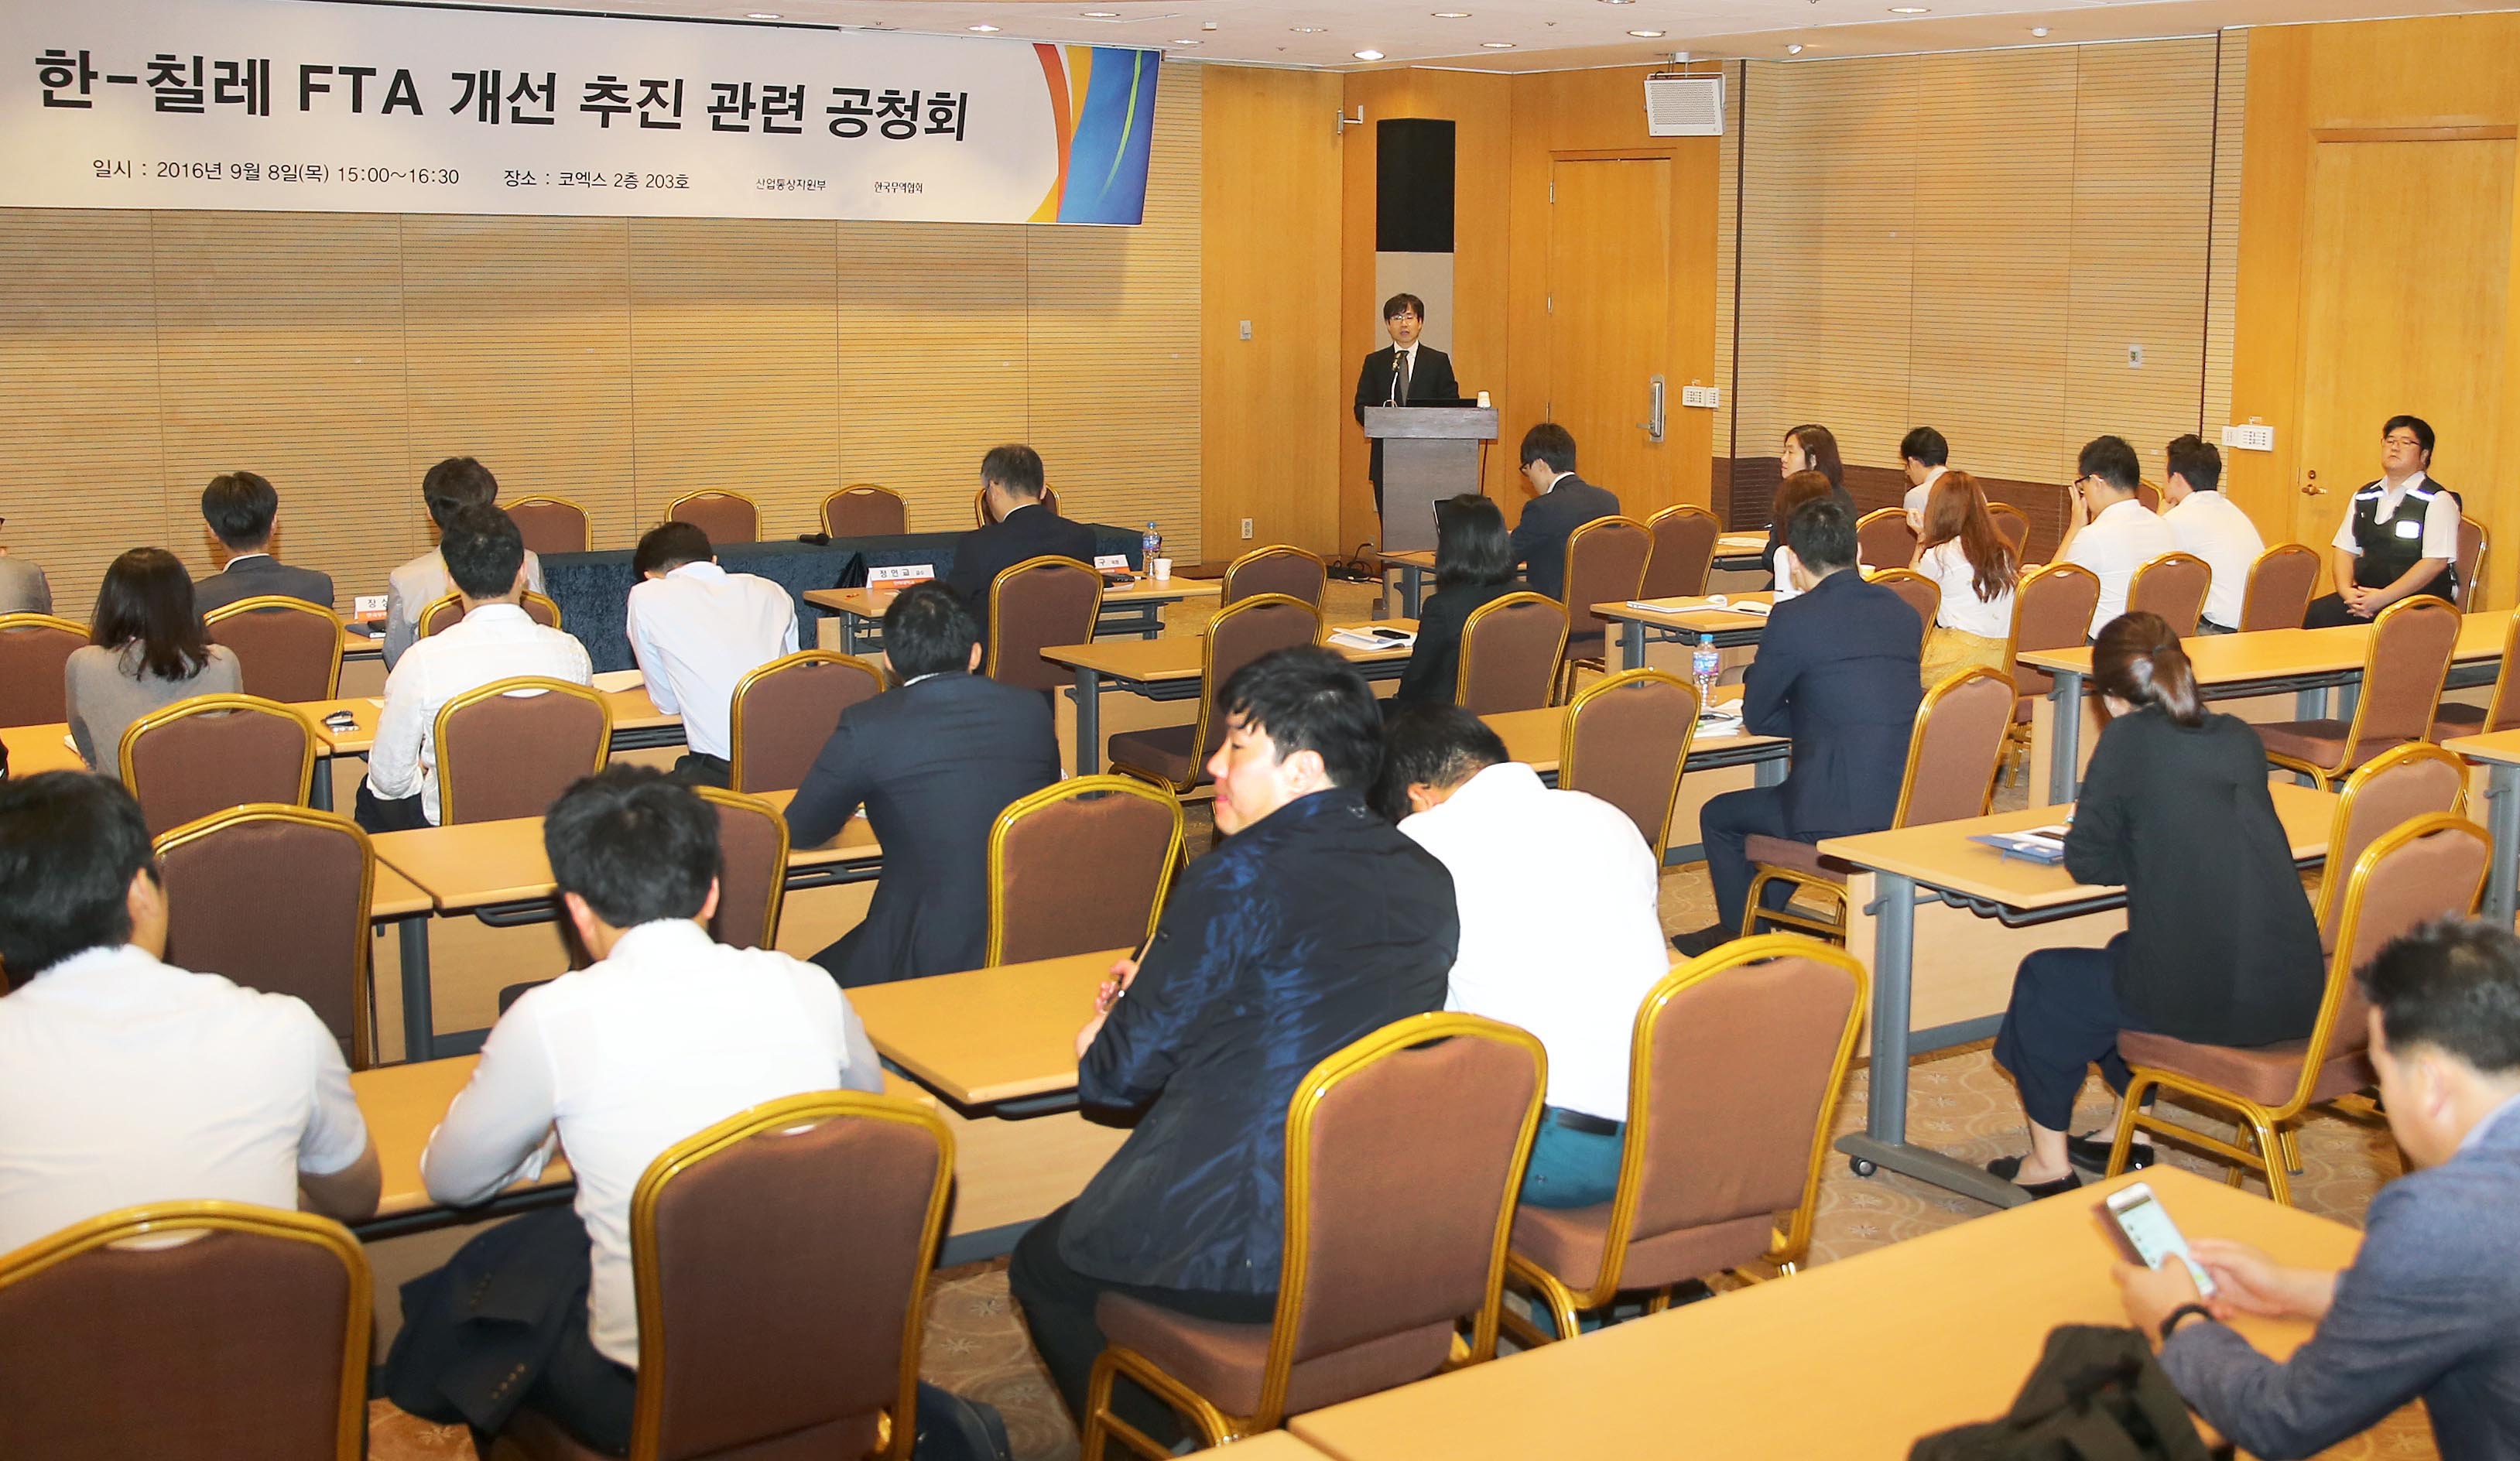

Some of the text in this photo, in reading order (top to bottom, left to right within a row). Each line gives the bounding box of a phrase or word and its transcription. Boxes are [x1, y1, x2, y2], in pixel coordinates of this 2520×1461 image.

[36, 49, 968, 142] 한-칠레 FTA 개선 추진 관련 공청회
[93, 159, 132, 179] 일시
[156, 161, 222, 180] 2016년
[230, 162, 260, 182] 9월
[268, 163, 329, 184] 8일(목)
[503, 169, 538, 188] 장소
[557, 171, 608, 189] 코엑스
[613, 172, 639, 190] 2층
[645, 173, 690, 190] 203호
[755, 178, 827, 191] 산업통상자원부
[874, 181, 923, 193] 한국무역협회
